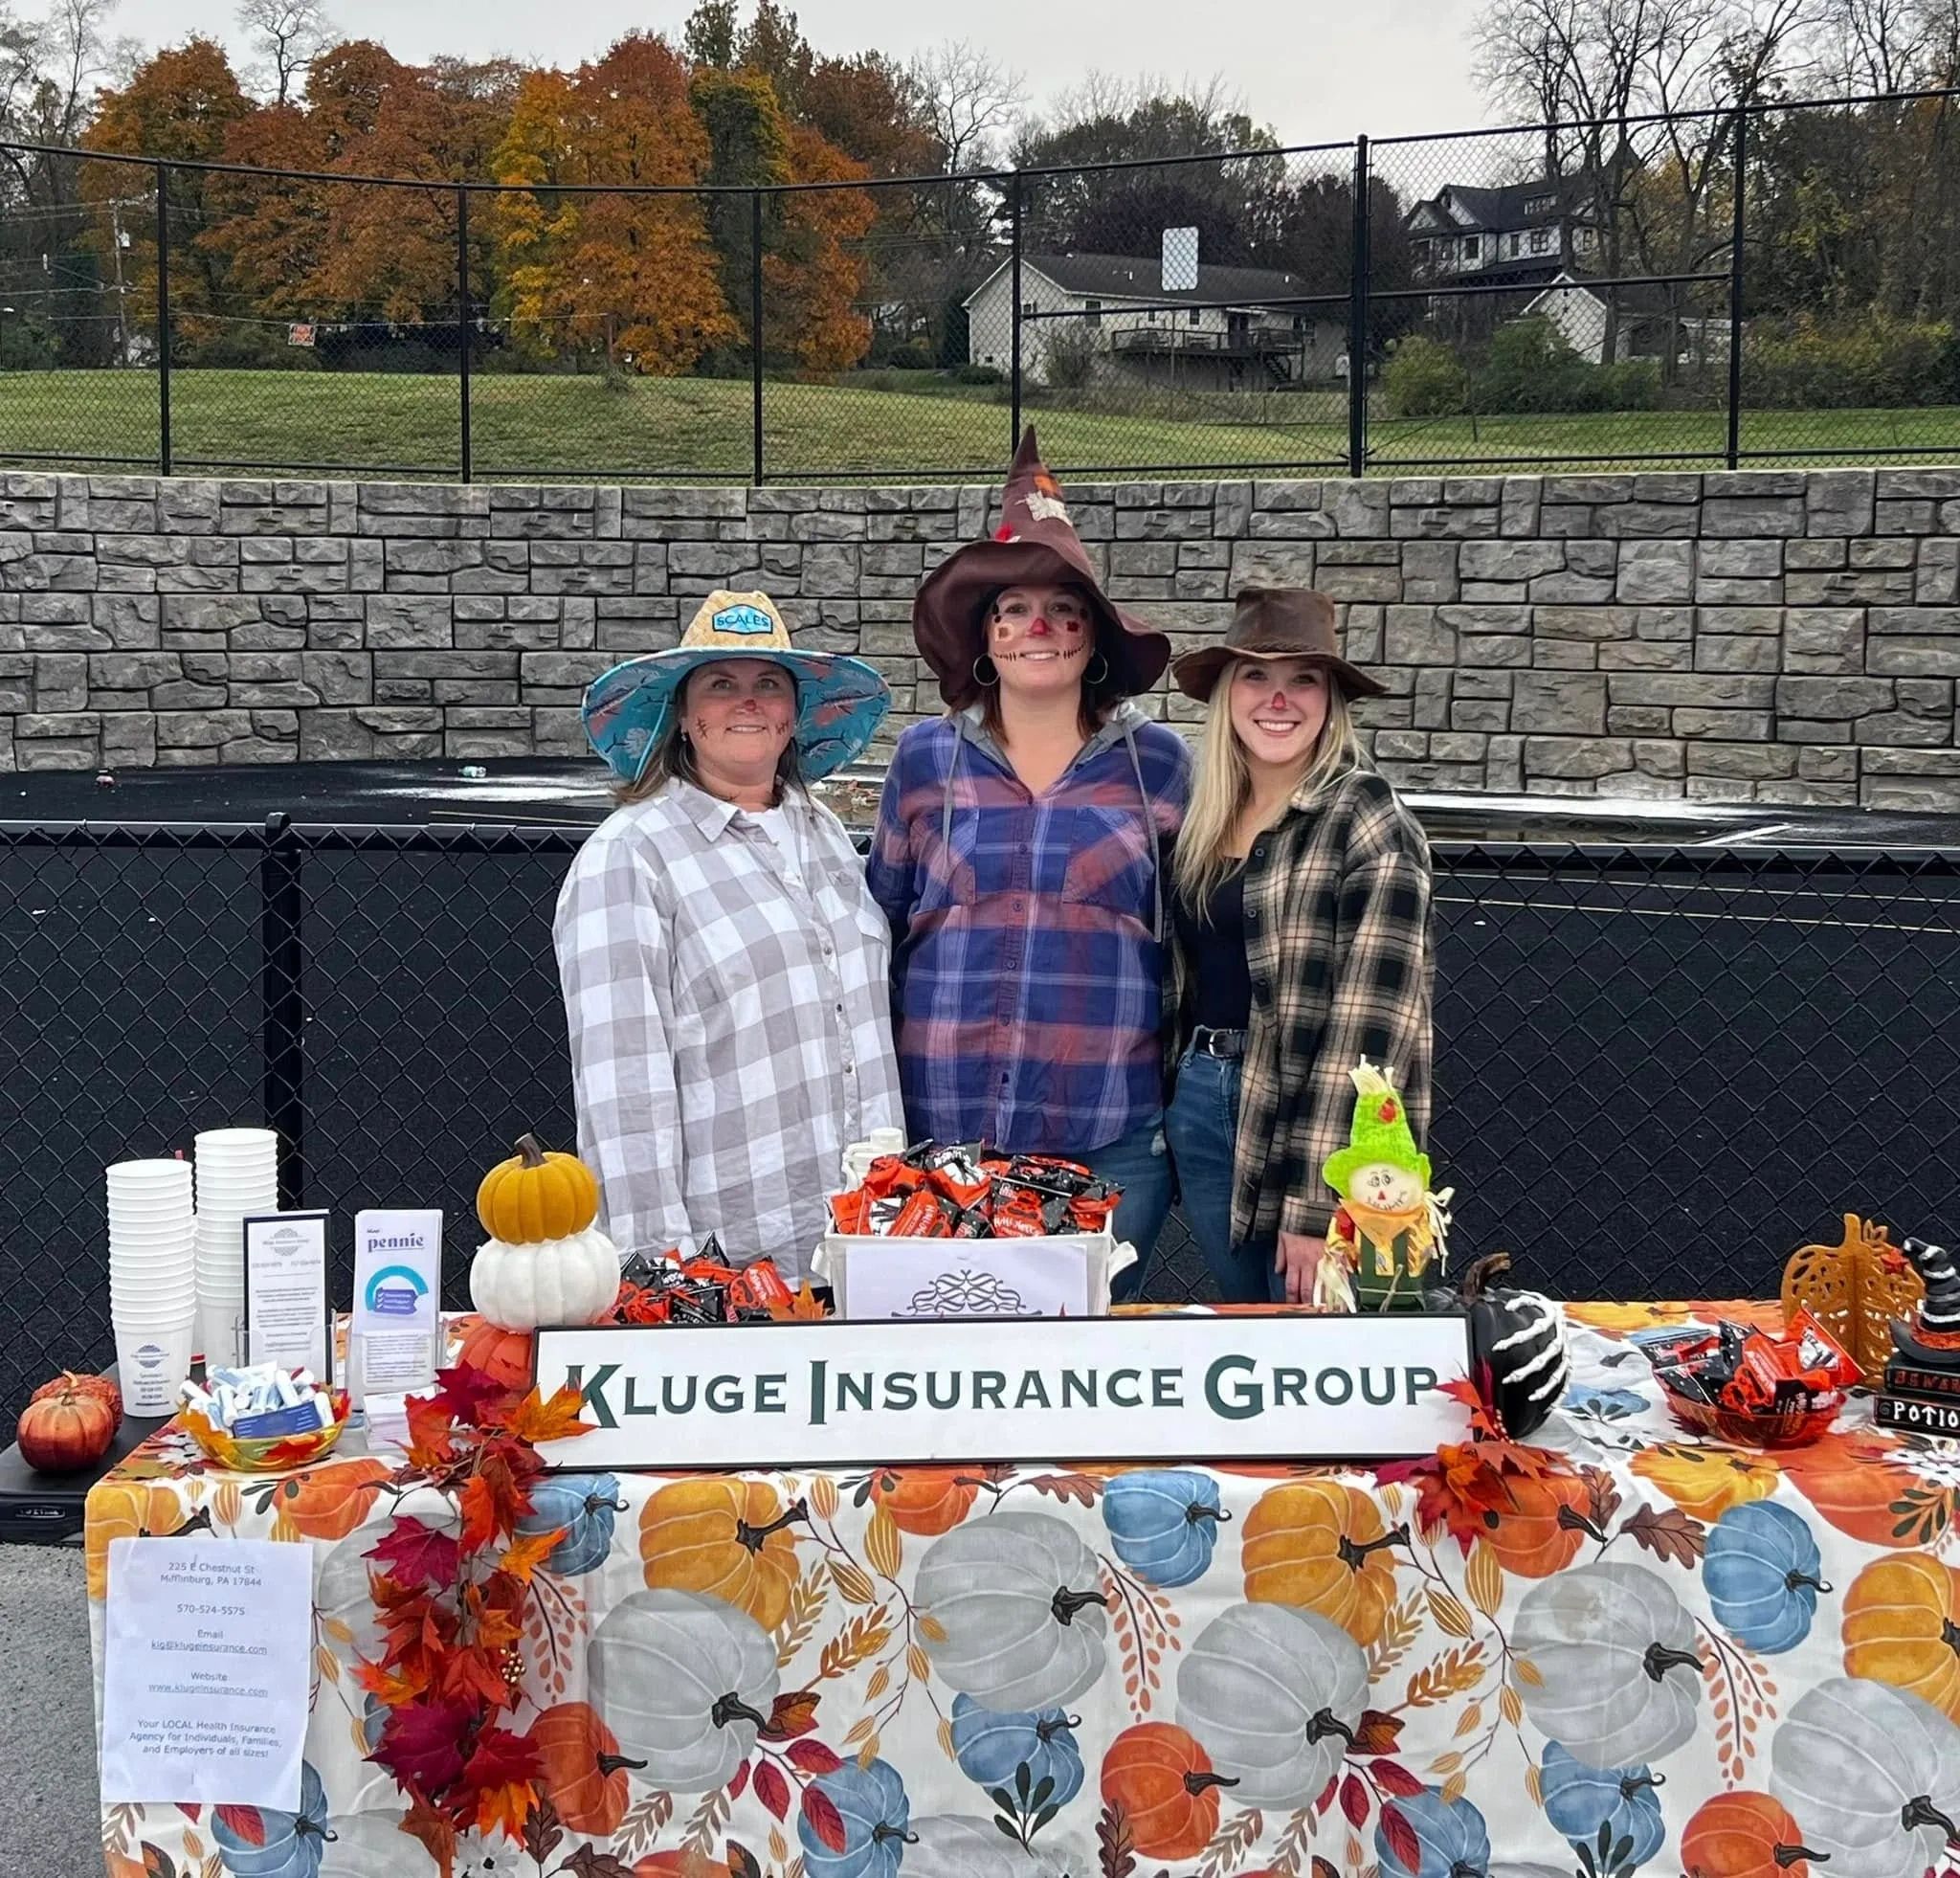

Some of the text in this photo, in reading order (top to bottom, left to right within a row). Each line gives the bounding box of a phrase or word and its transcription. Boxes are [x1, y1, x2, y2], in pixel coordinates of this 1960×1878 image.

[716, 614, 769, 628] SCALES
[368, 1232, 424, 1253] pennie
[566, 1353, 1437, 1429] KLUGE INSURANCE GROUP
[168, 1561, 188, 1572] 225
[198, 1562, 241, 1575] Chestnut
[244, 1564, 256, 1575] St
[216, 1576, 230, 1586] PA
[233, 1577, 262, 1586] 17844
[176, 1603, 246, 1616] 570-524-5575
[197, 1629, 224, 1640] Email
[190, 1671, 228, 1682] Website
[138, 1719, 276, 1734] Your LOCAL Health Insurance
[129, 1732, 165, 1743] Agency
[167, 1732, 182, 1742] for
[143, 1744, 161, 1755] and
[164, 1745, 213, 1755] Employers
[216, 1746, 227, 1755] of
[230, 1747, 239, 1756] all
